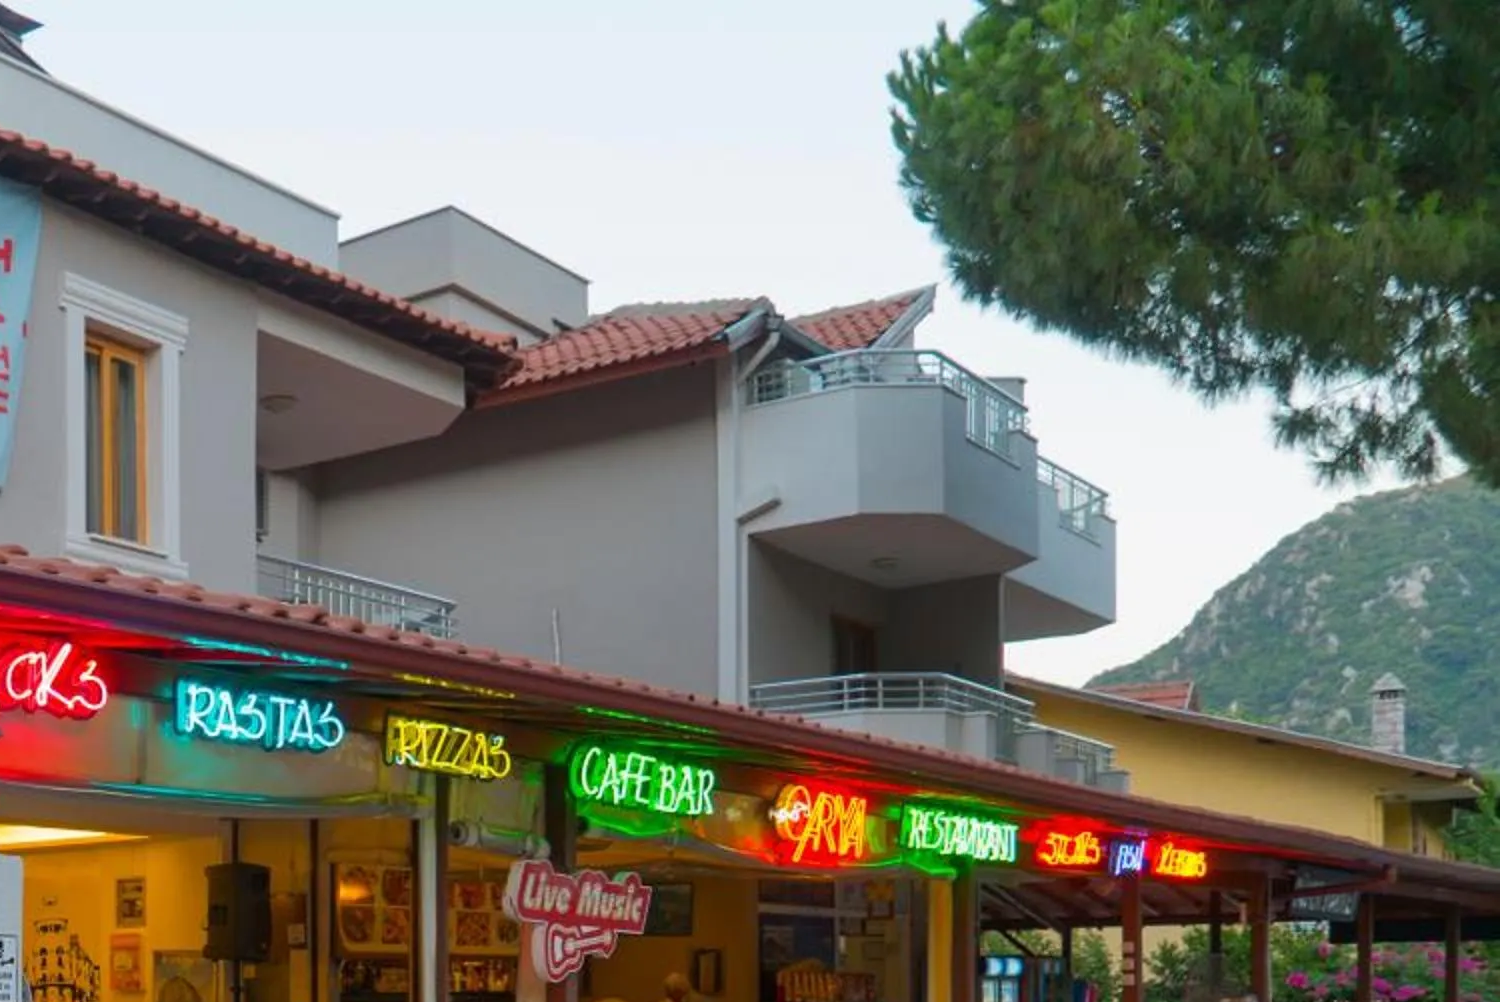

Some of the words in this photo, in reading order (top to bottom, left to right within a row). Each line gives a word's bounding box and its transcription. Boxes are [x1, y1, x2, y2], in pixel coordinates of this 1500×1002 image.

[581, 746, 657, 805] CAFE
[655, 763, 715, 815] BAR
[908, 807, 1020, 863] RESTAURANT
[523, 872, 572, 915] Live
[576, 880, 644, 924] Music
